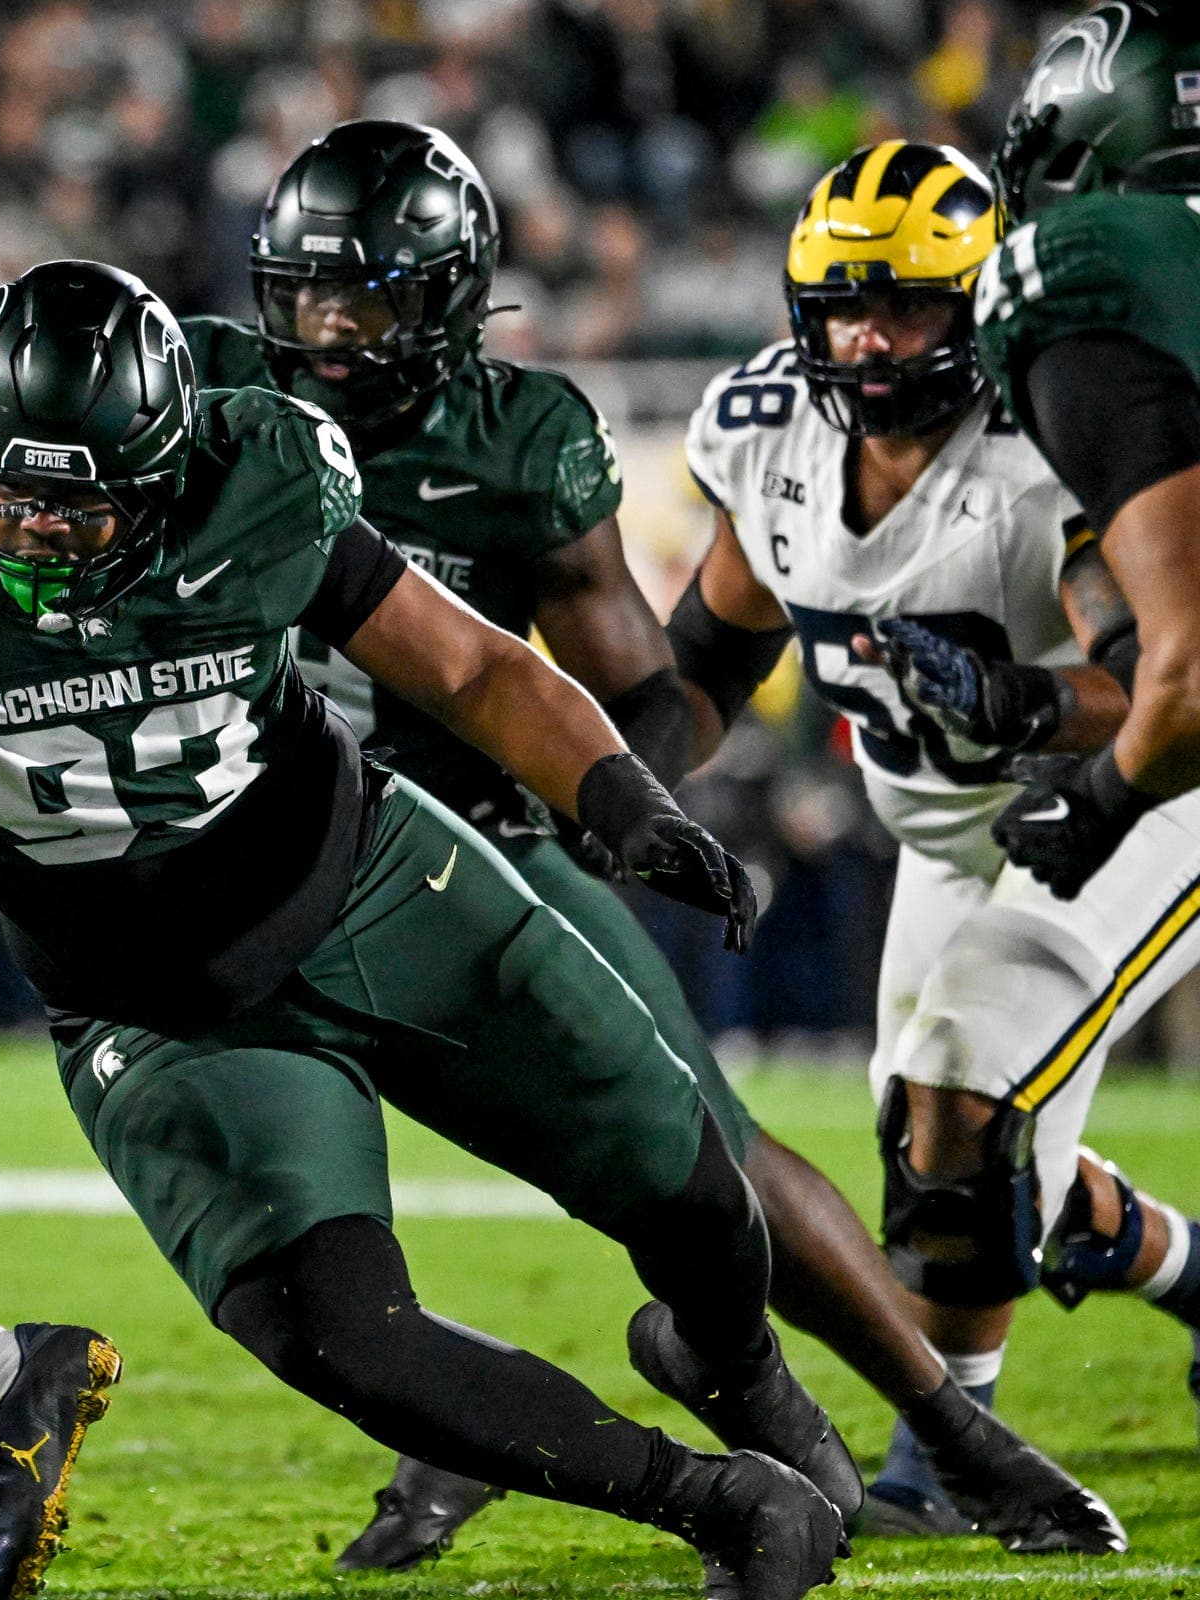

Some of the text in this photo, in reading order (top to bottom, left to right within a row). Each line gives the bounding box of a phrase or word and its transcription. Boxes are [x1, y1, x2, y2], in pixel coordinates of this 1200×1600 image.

[24, 448, 71, 469] STATE
[771, 534, 790, 577] C
[150, 645, 256, 697] STATE
